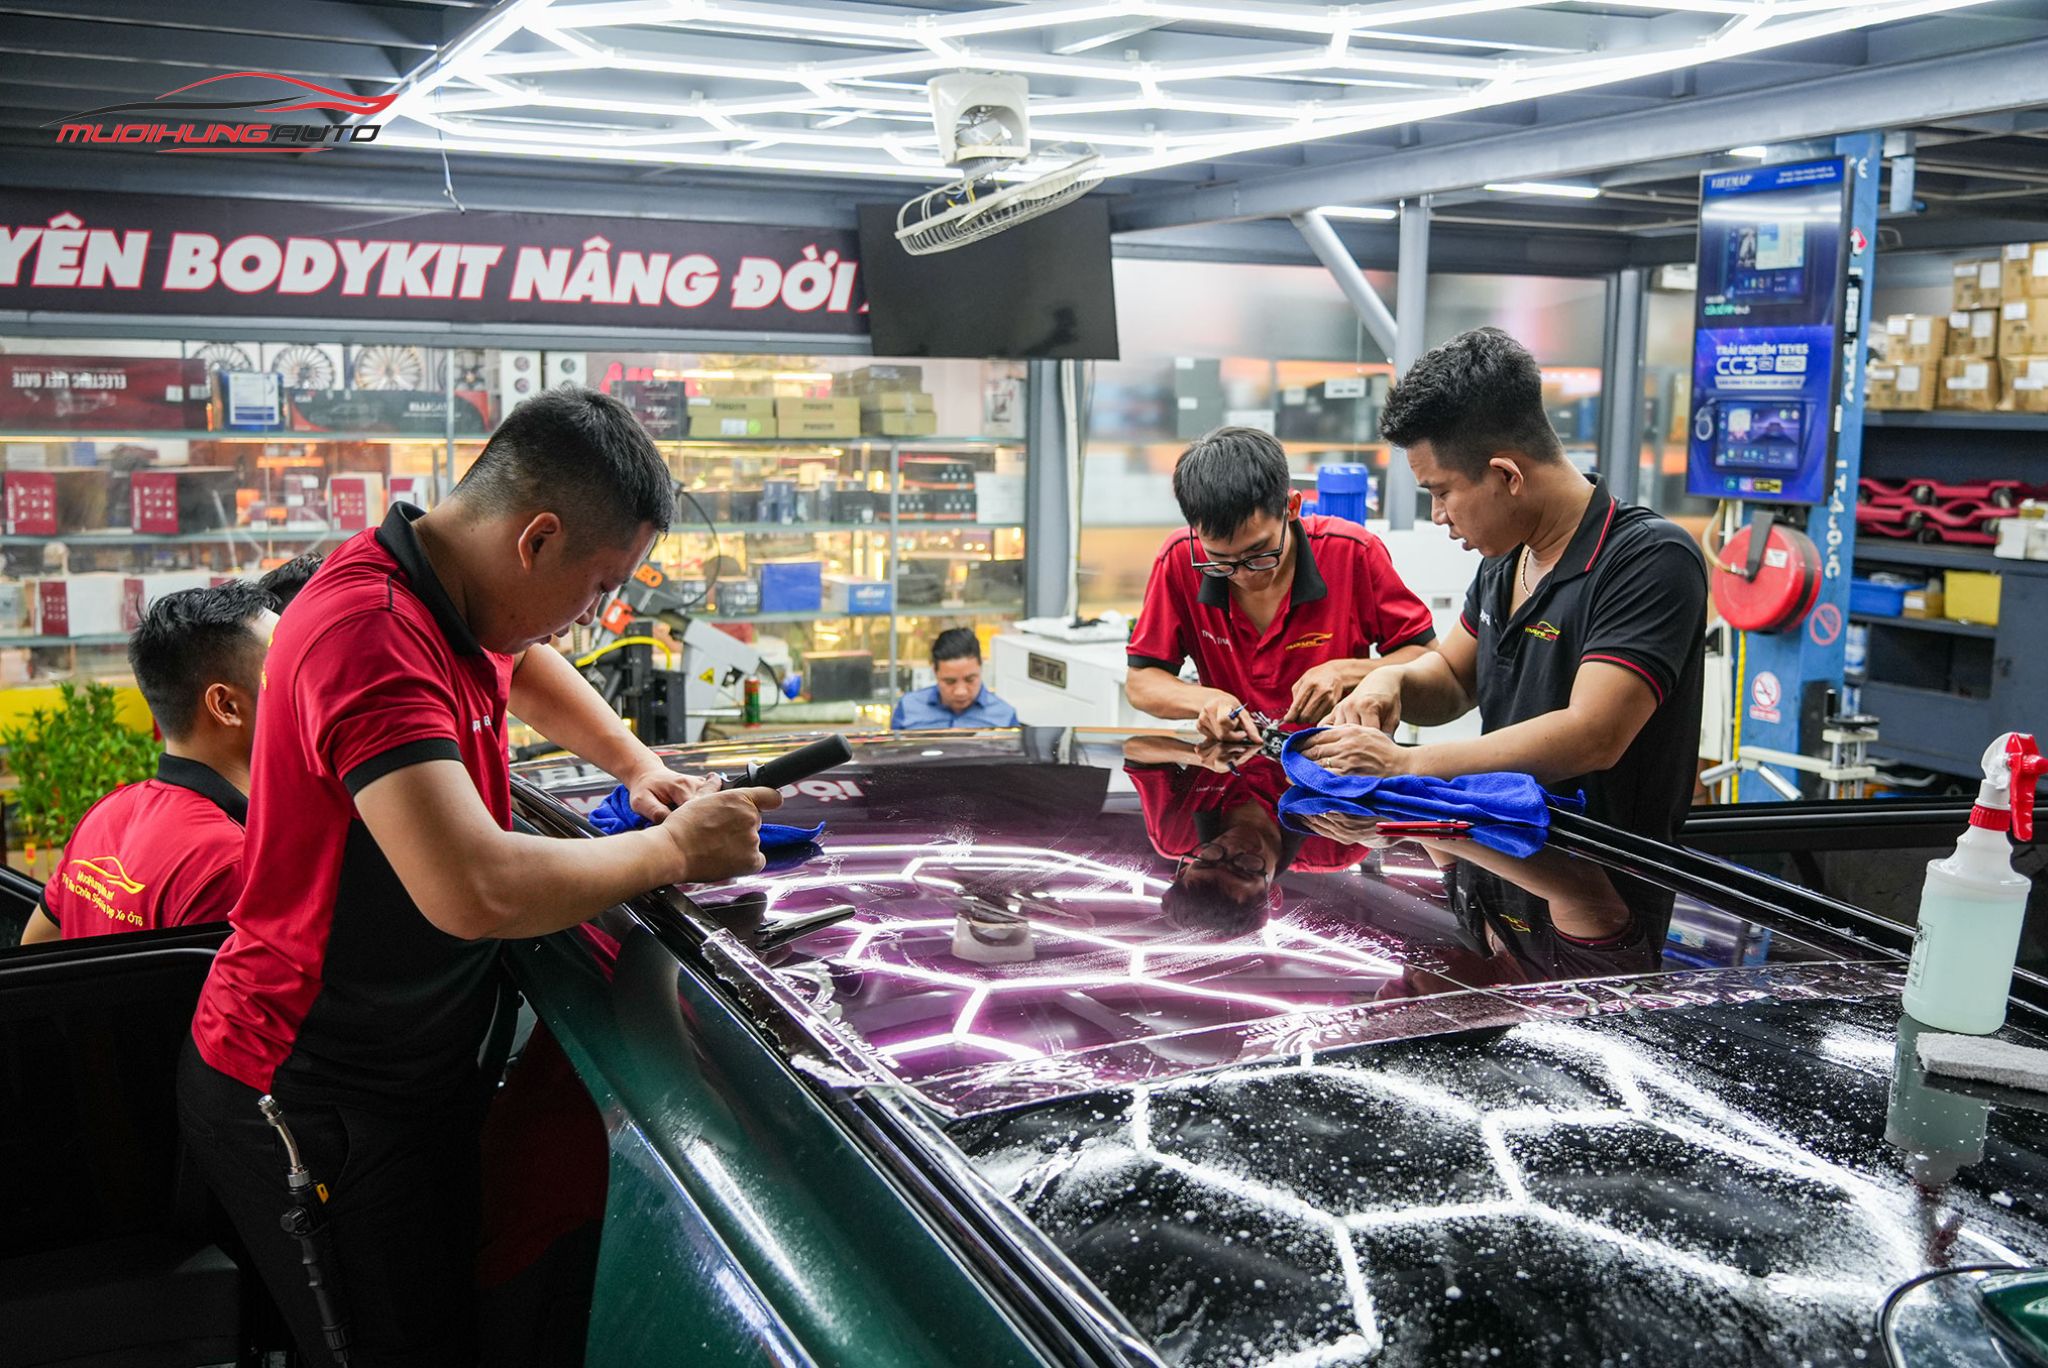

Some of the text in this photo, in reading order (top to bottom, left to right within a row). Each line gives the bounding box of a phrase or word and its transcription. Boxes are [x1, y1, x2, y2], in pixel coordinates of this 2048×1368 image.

[162, 231, 503, 300] BODYKIT
[509, 235, 721, 308] NÂNG
[730, 244, 858, 312] ĐỜI
[1716, 356, 1757, 375] CC3
